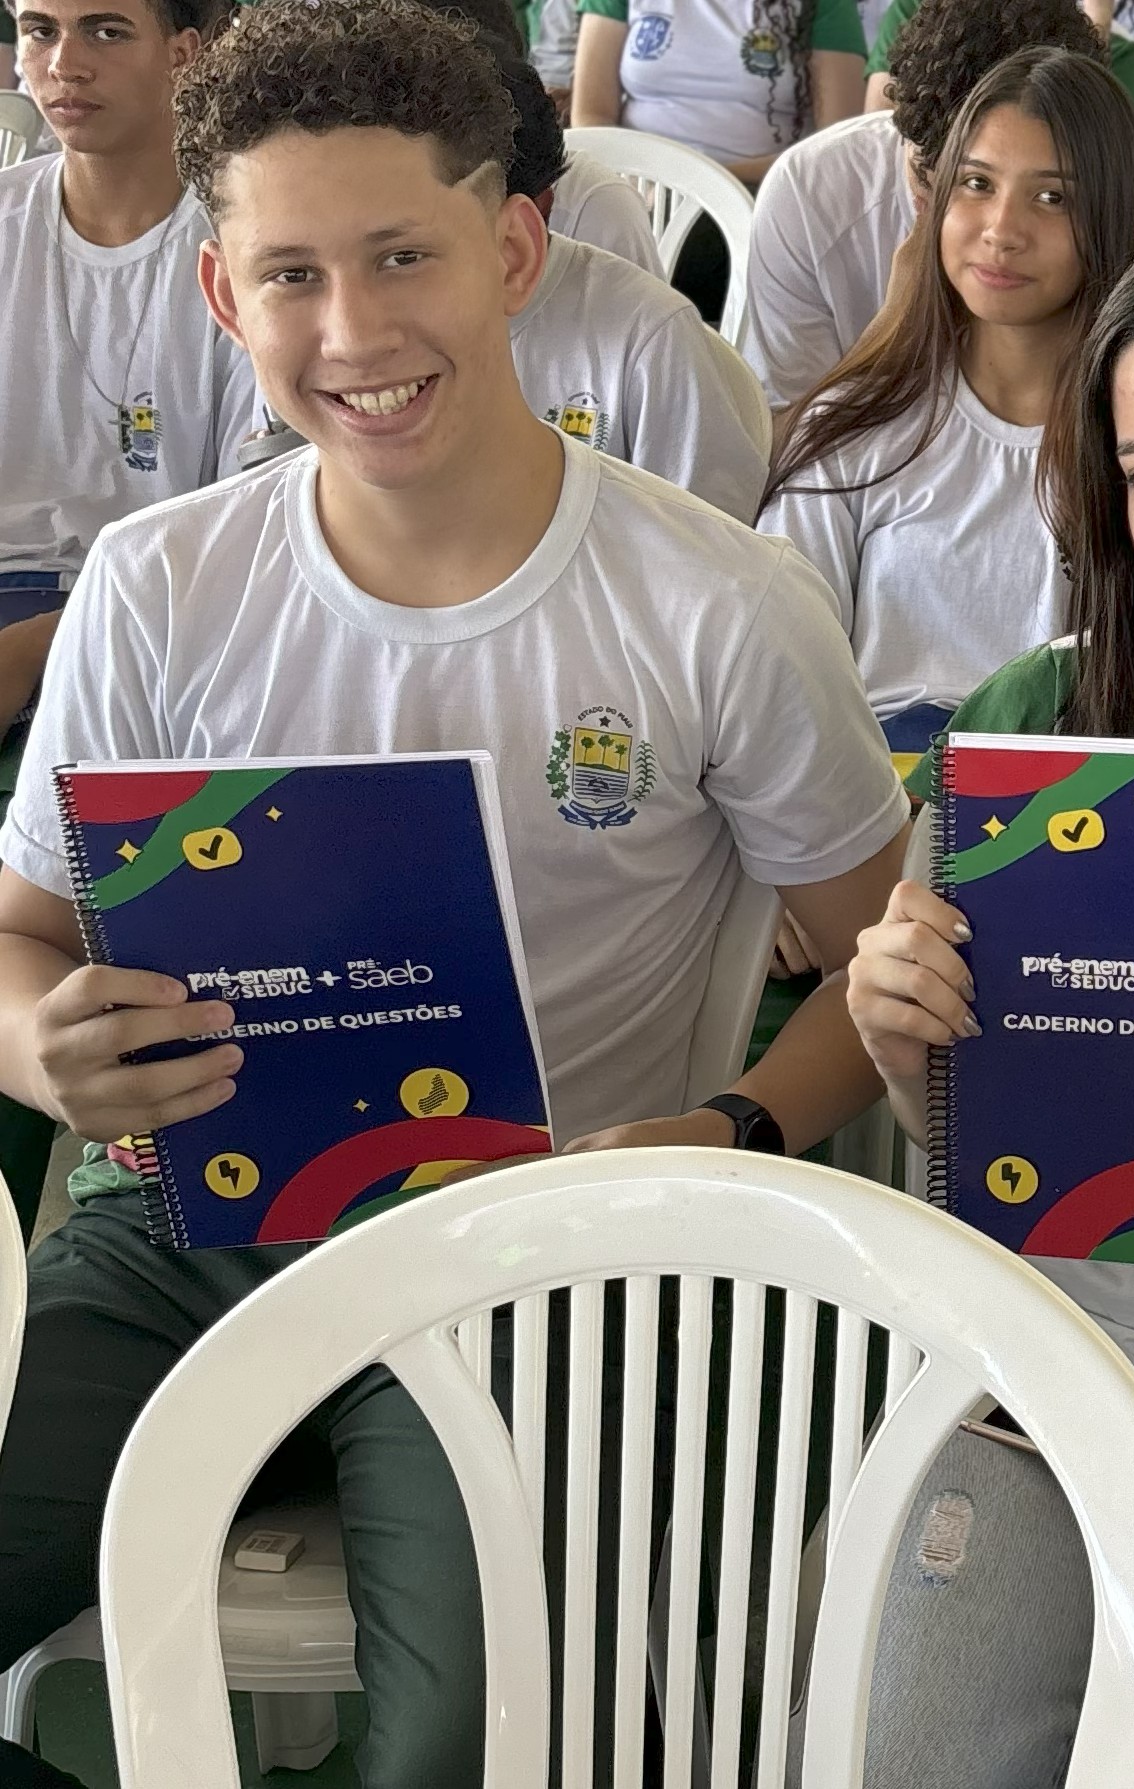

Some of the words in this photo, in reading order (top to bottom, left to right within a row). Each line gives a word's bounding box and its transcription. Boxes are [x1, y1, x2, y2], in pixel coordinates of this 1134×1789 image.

[577, 705, 604, 721] ESTADO
[605, 706, 617, 715] DO
[187, 966, 309, 993] pré-enem
[349, 959, 434, 990] saeb
[240, 981, 313, 999] SEDUC
[186, 1019, 299, 1041] DERNO
[303, 1015, 336, 1032] DE
[339, 1004, 462, 1029] QUESTÕES
[1003, 1013, 1114, 1034] CADERNO
